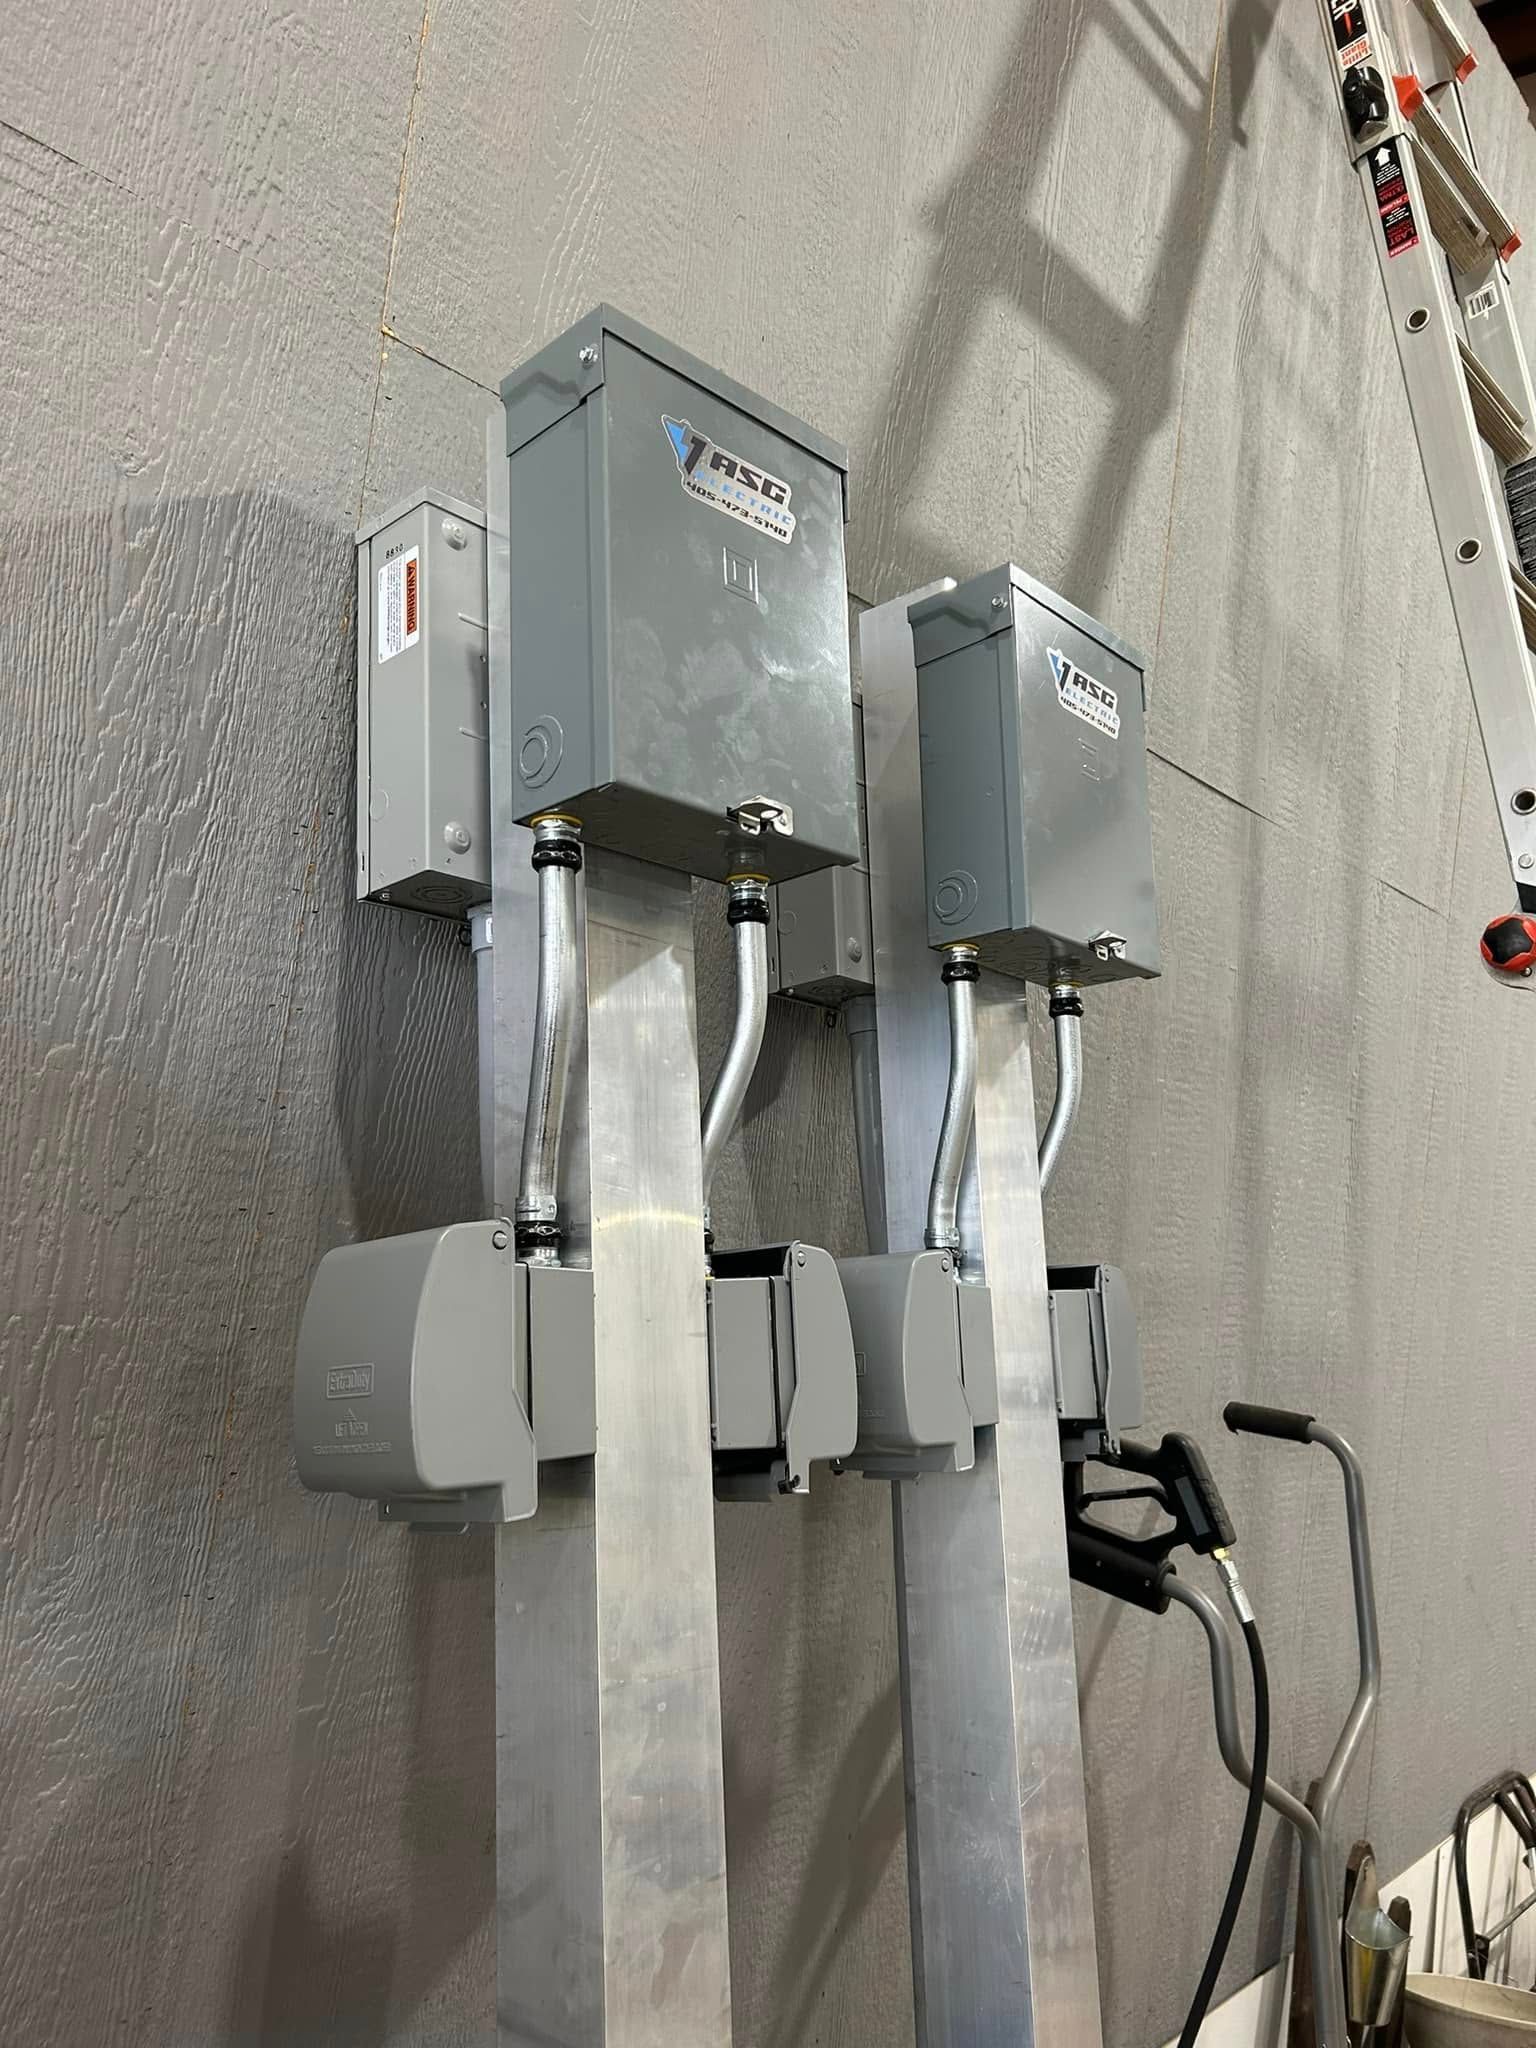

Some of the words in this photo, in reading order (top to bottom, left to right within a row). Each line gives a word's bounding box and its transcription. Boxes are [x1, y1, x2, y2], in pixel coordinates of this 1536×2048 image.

[1341, 40, 1367, 60] Giant
[686, 481, 788, 538] 405-473-5140
[694, 470, 793, 526] ELECTRIC
[407, 574, 418, 632] WARNING
